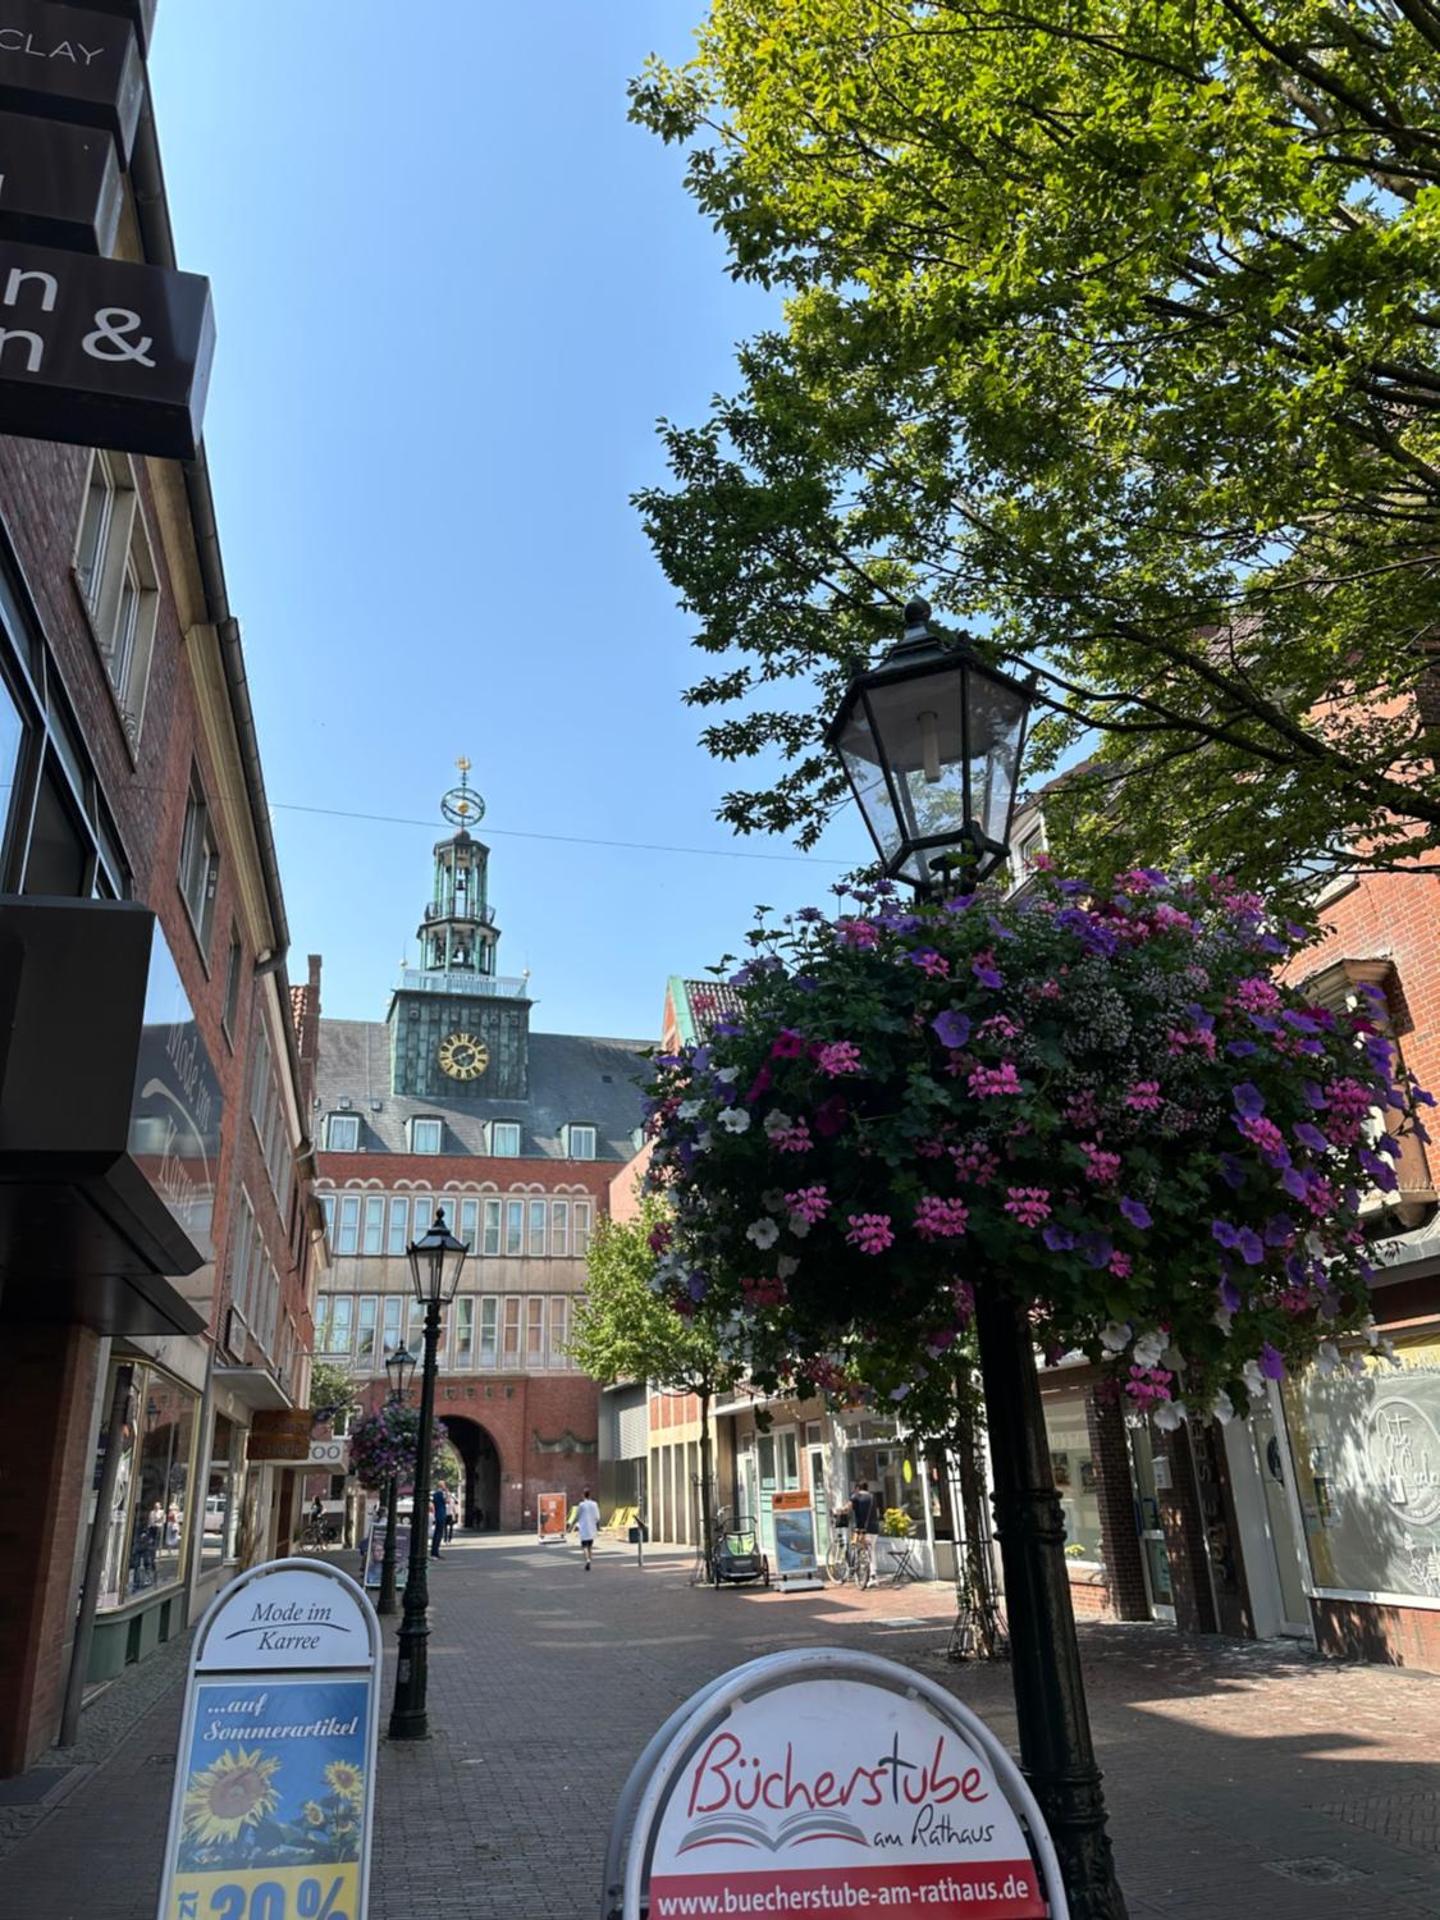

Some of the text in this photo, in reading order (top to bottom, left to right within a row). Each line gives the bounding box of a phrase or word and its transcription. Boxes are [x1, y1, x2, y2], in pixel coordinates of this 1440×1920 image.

[81, 307, 156, 368] &
[251, 1602, 332, 1622] Mode im
[257, 1630, 321, 1651] Karree
[207, 1692, 268, 1717] ...auf
[203, 1716, 359, 1741] Sommerartikel
[687, 1731, 990, 1819] Bücherstube
[873, 1803, 995, 1849] am Rathaus
[658, 1874, 1030, 1917] www.buecherstube-am-rathaus.de
